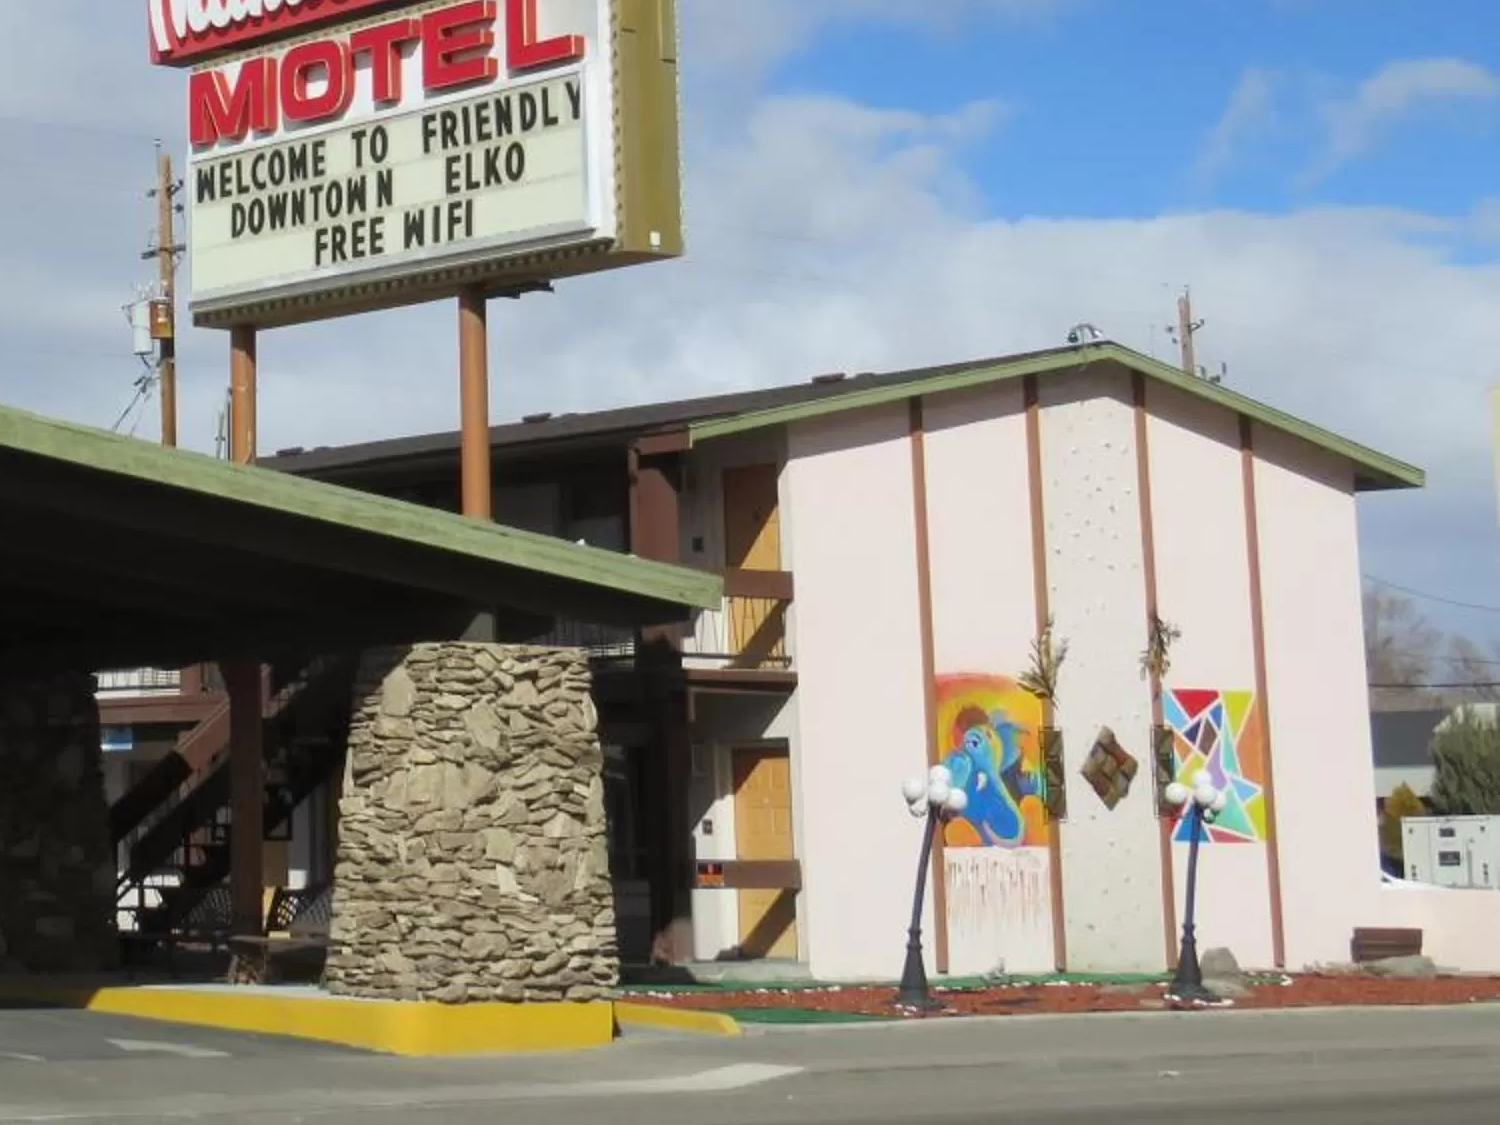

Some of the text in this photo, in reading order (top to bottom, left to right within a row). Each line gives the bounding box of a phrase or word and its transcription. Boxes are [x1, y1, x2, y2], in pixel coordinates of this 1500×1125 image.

[196, 81, 581, 204] WELCOME TO FRIENDLY
[231, 141, 526, 239] DOWNTOWN ELKO
[314, 198, 474, 266] FREE WIFI
